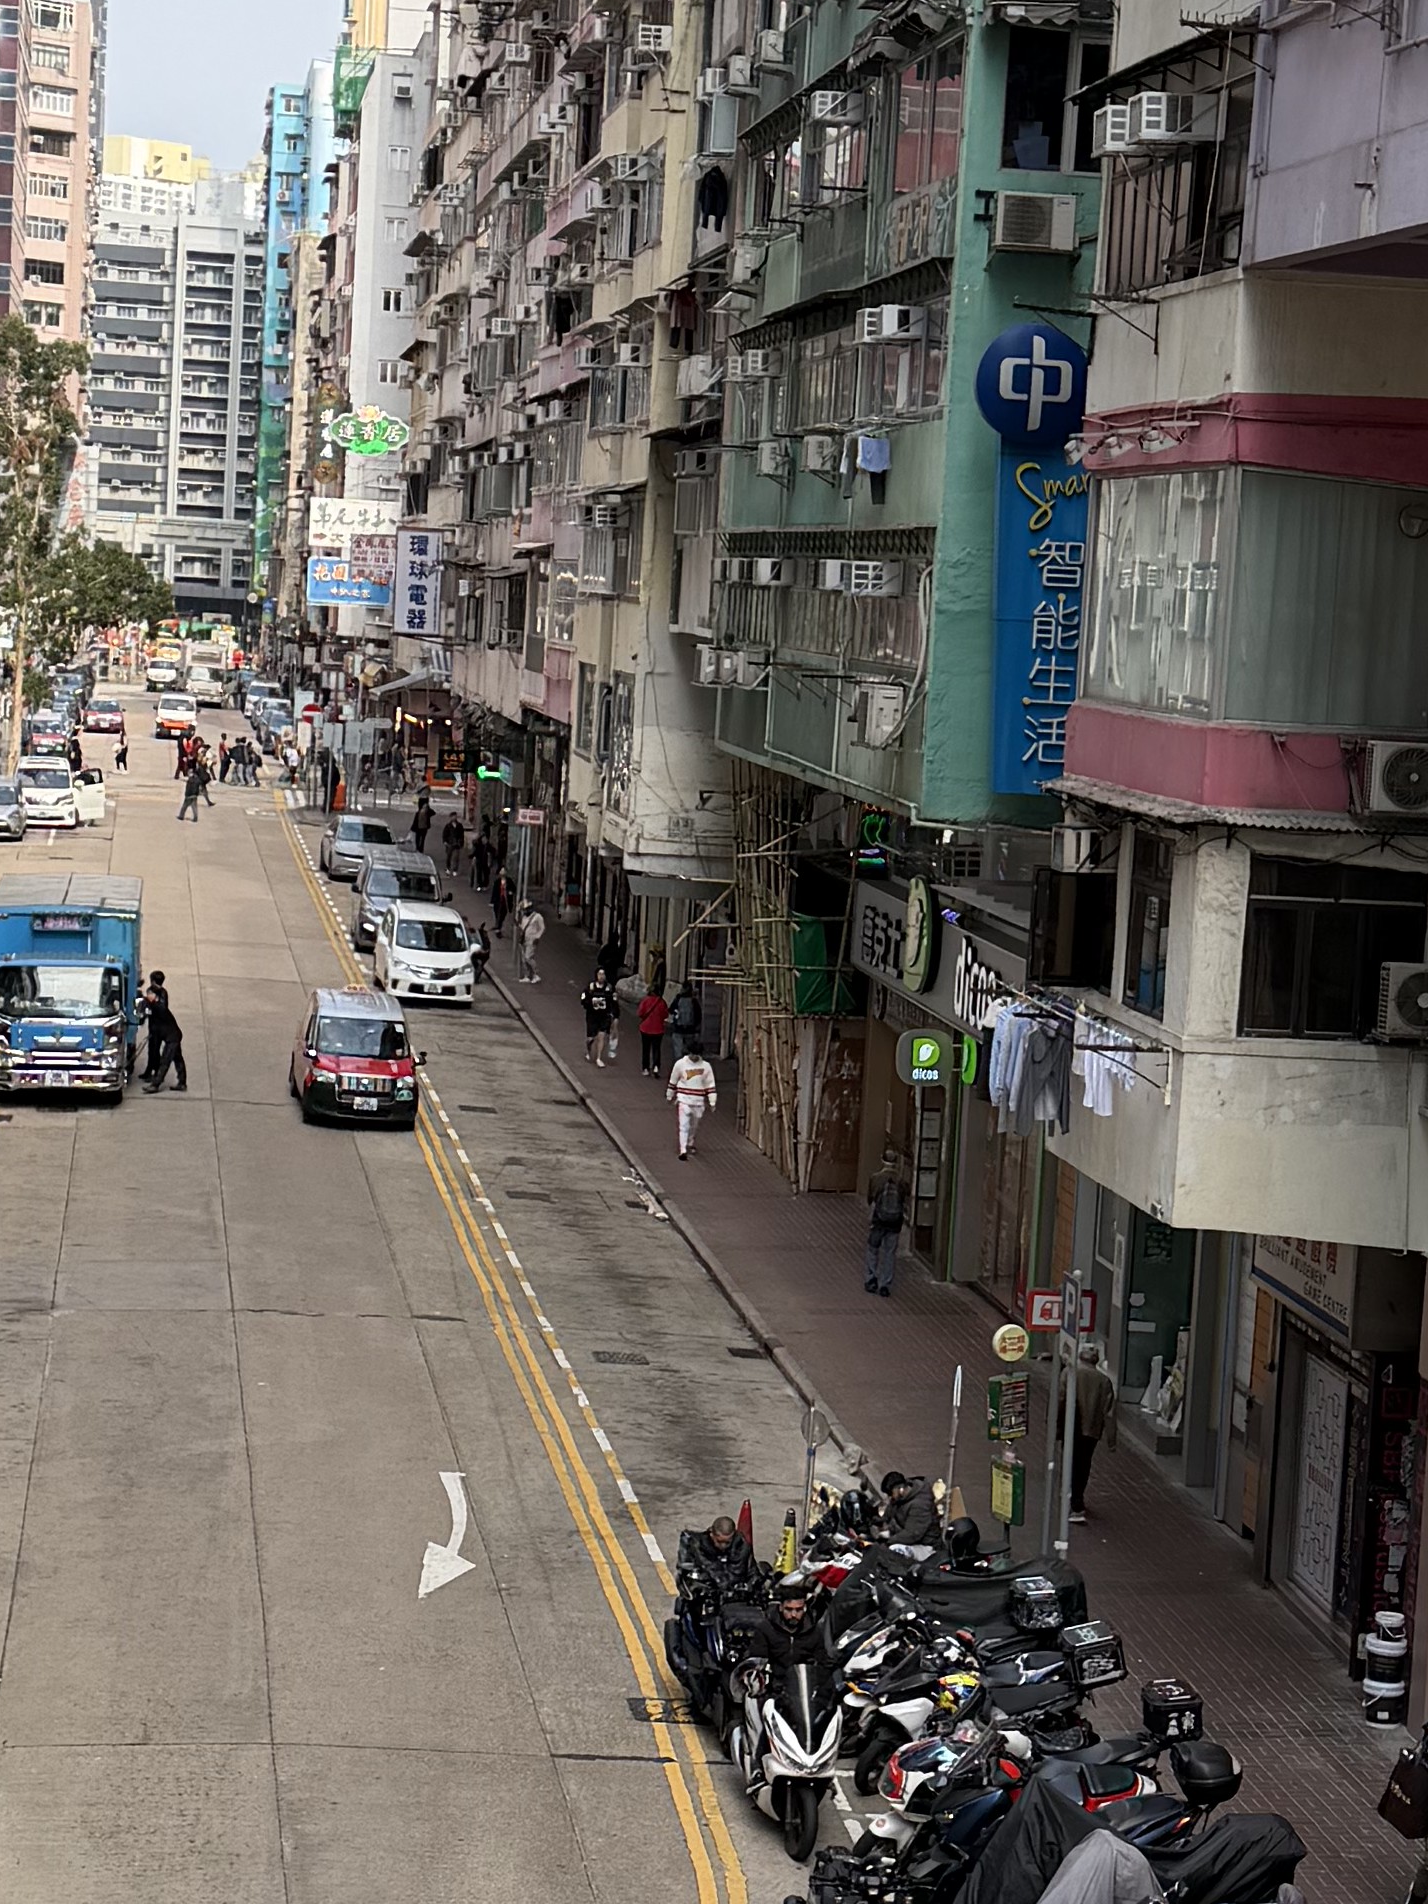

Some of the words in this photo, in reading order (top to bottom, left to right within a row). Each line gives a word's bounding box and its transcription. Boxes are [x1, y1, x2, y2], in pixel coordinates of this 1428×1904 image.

[339, 422, 403, 442] 蓮香居
[1016, 462, 1091, 531] Smar
[407, 535, 429, 630] 環球電器
[1021, 538, 1085, 766] 智能生活
[912, 1068, 939, 1080] dicos
[1064, 1286, 1075, 1332] P
[1303, 1280, 1322, 1304] GAME
[1323, 1291, 1348, 1321] CENTRE
